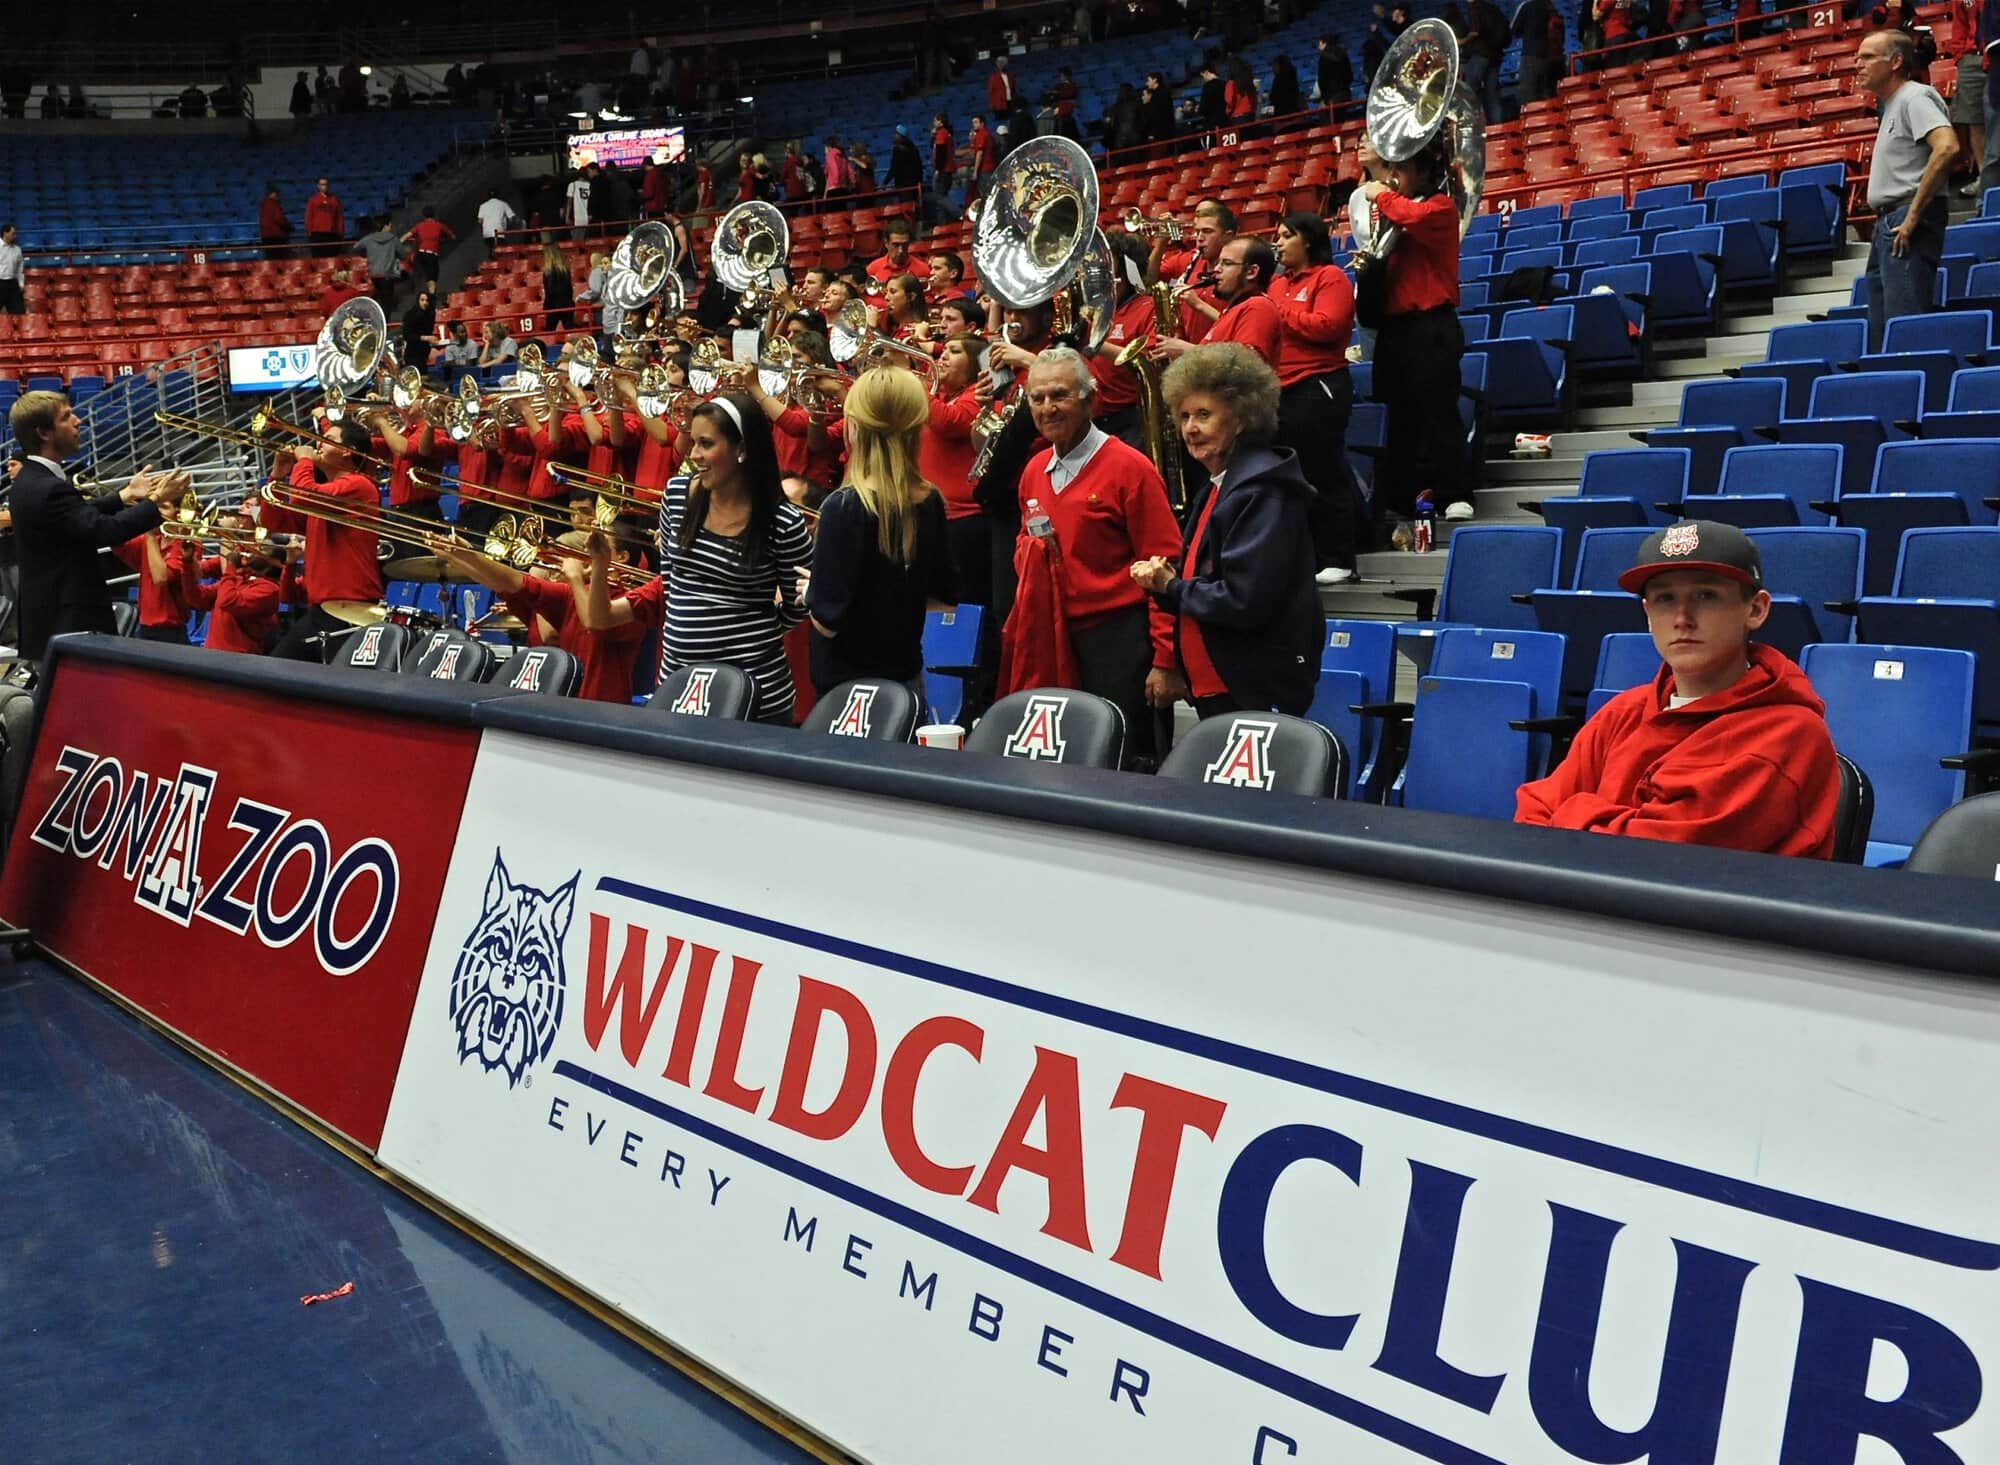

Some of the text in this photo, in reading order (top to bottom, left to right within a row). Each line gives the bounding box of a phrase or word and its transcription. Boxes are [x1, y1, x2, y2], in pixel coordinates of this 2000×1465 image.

[1813, 9, 1834, 27] 21
[566, 132, 606, 145] OFFICIAL
[607, 130, 639, 141] ONLINE
[1222, 133, 1237, 147] 20
[579, 187, 589, 200] 15
[193, 253, 206, 265] 18
[520, 318, 534, 332] 19
[351, 627, 384, 665] A
[430, 644, 464, 680] A
[510, 652, 548, 692] A
[671, 668, 718, 717] A
[829, 684, 880, 738] A
[1003, 695, 1069, 763] A
[1203, 718, 1278, 791] A
[31, 745, 400, 976] ZONA ZOO
[547, 1096, 731, 1207] EVERY
[783, 1207, 1151, 1417] MEMBER
